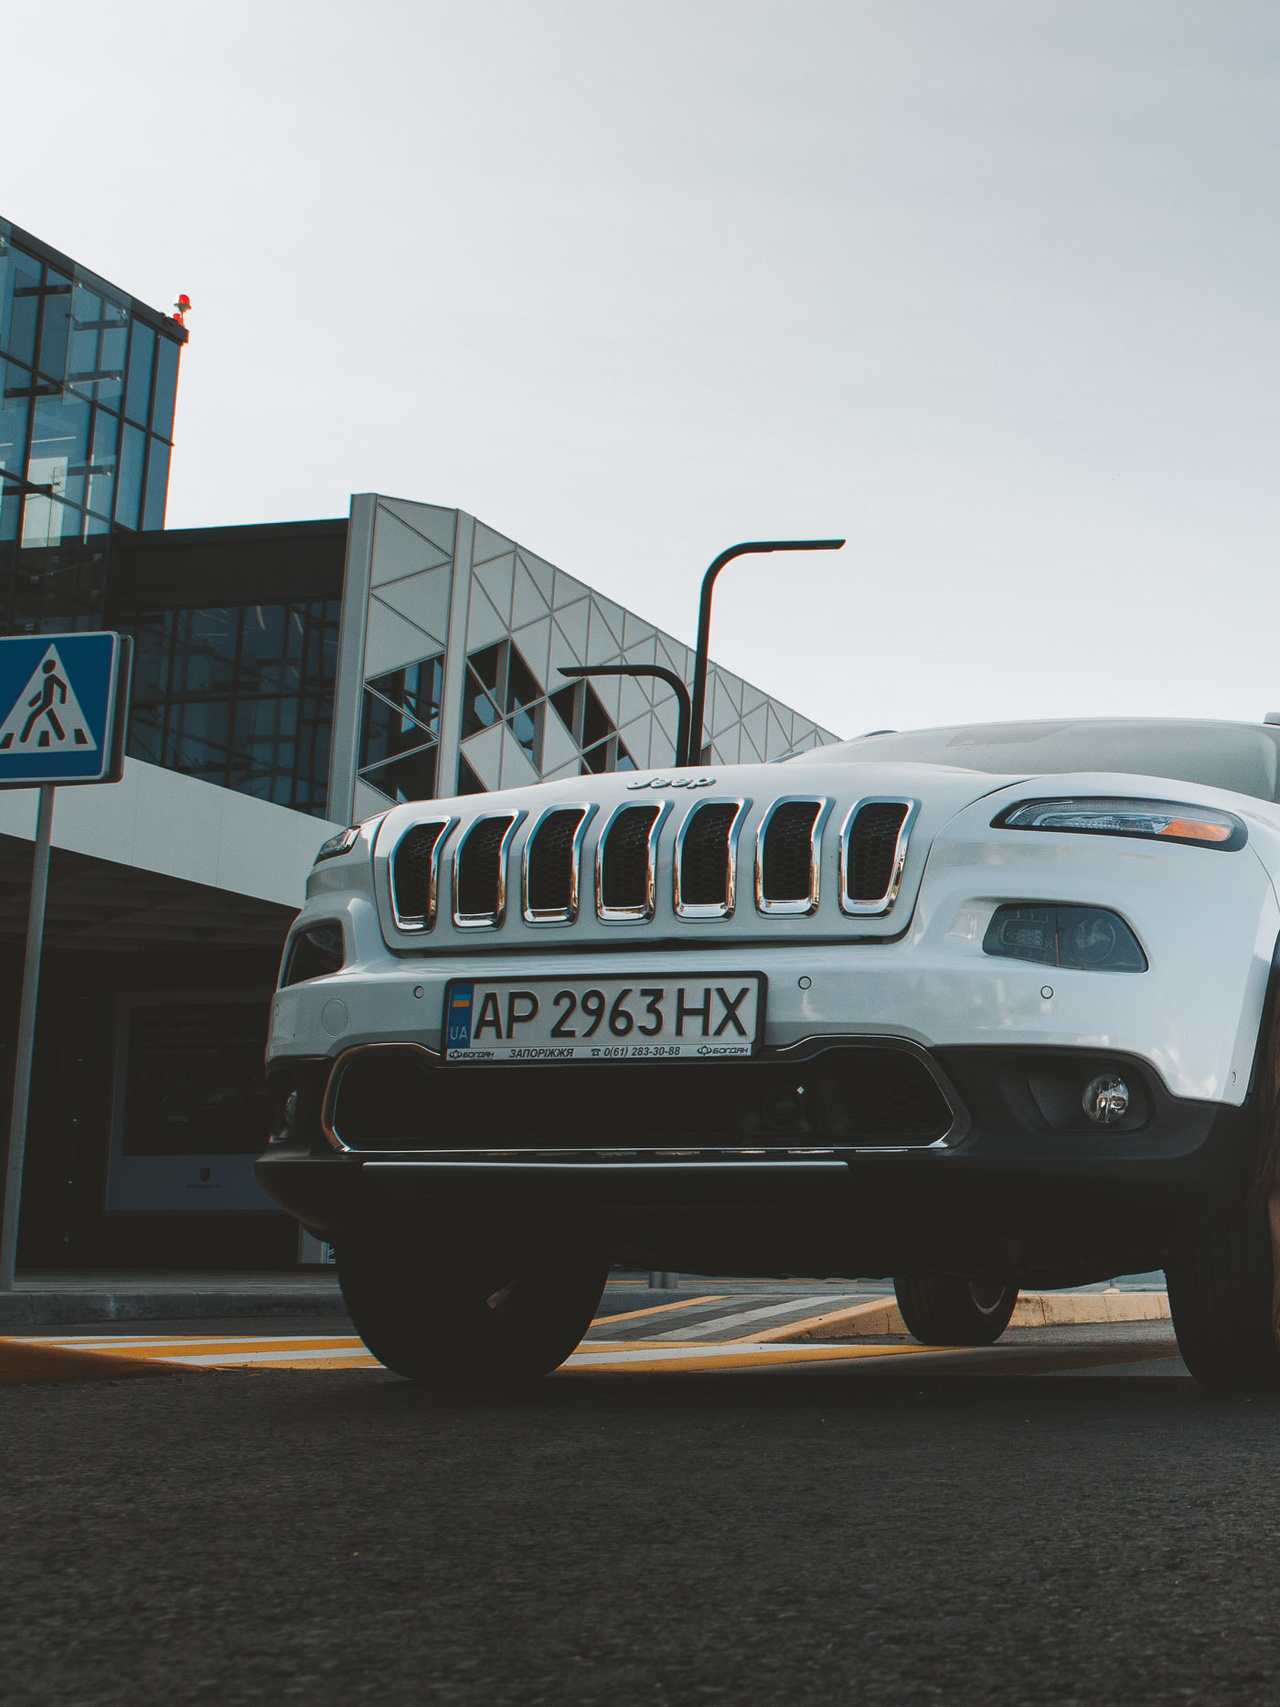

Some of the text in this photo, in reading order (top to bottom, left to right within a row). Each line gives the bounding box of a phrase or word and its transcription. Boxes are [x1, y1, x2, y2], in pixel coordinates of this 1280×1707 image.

[627, 777, 717, 789] Jeep
[473, 987, 750, 1040] AP 2963 HX
[450, 1026, 468, 1040] UA
[509, 1048, 574, 1059] ЗАПОРІЖЖЯ
[603, 1046, 680, 1058] 0(61) 283-30-88
